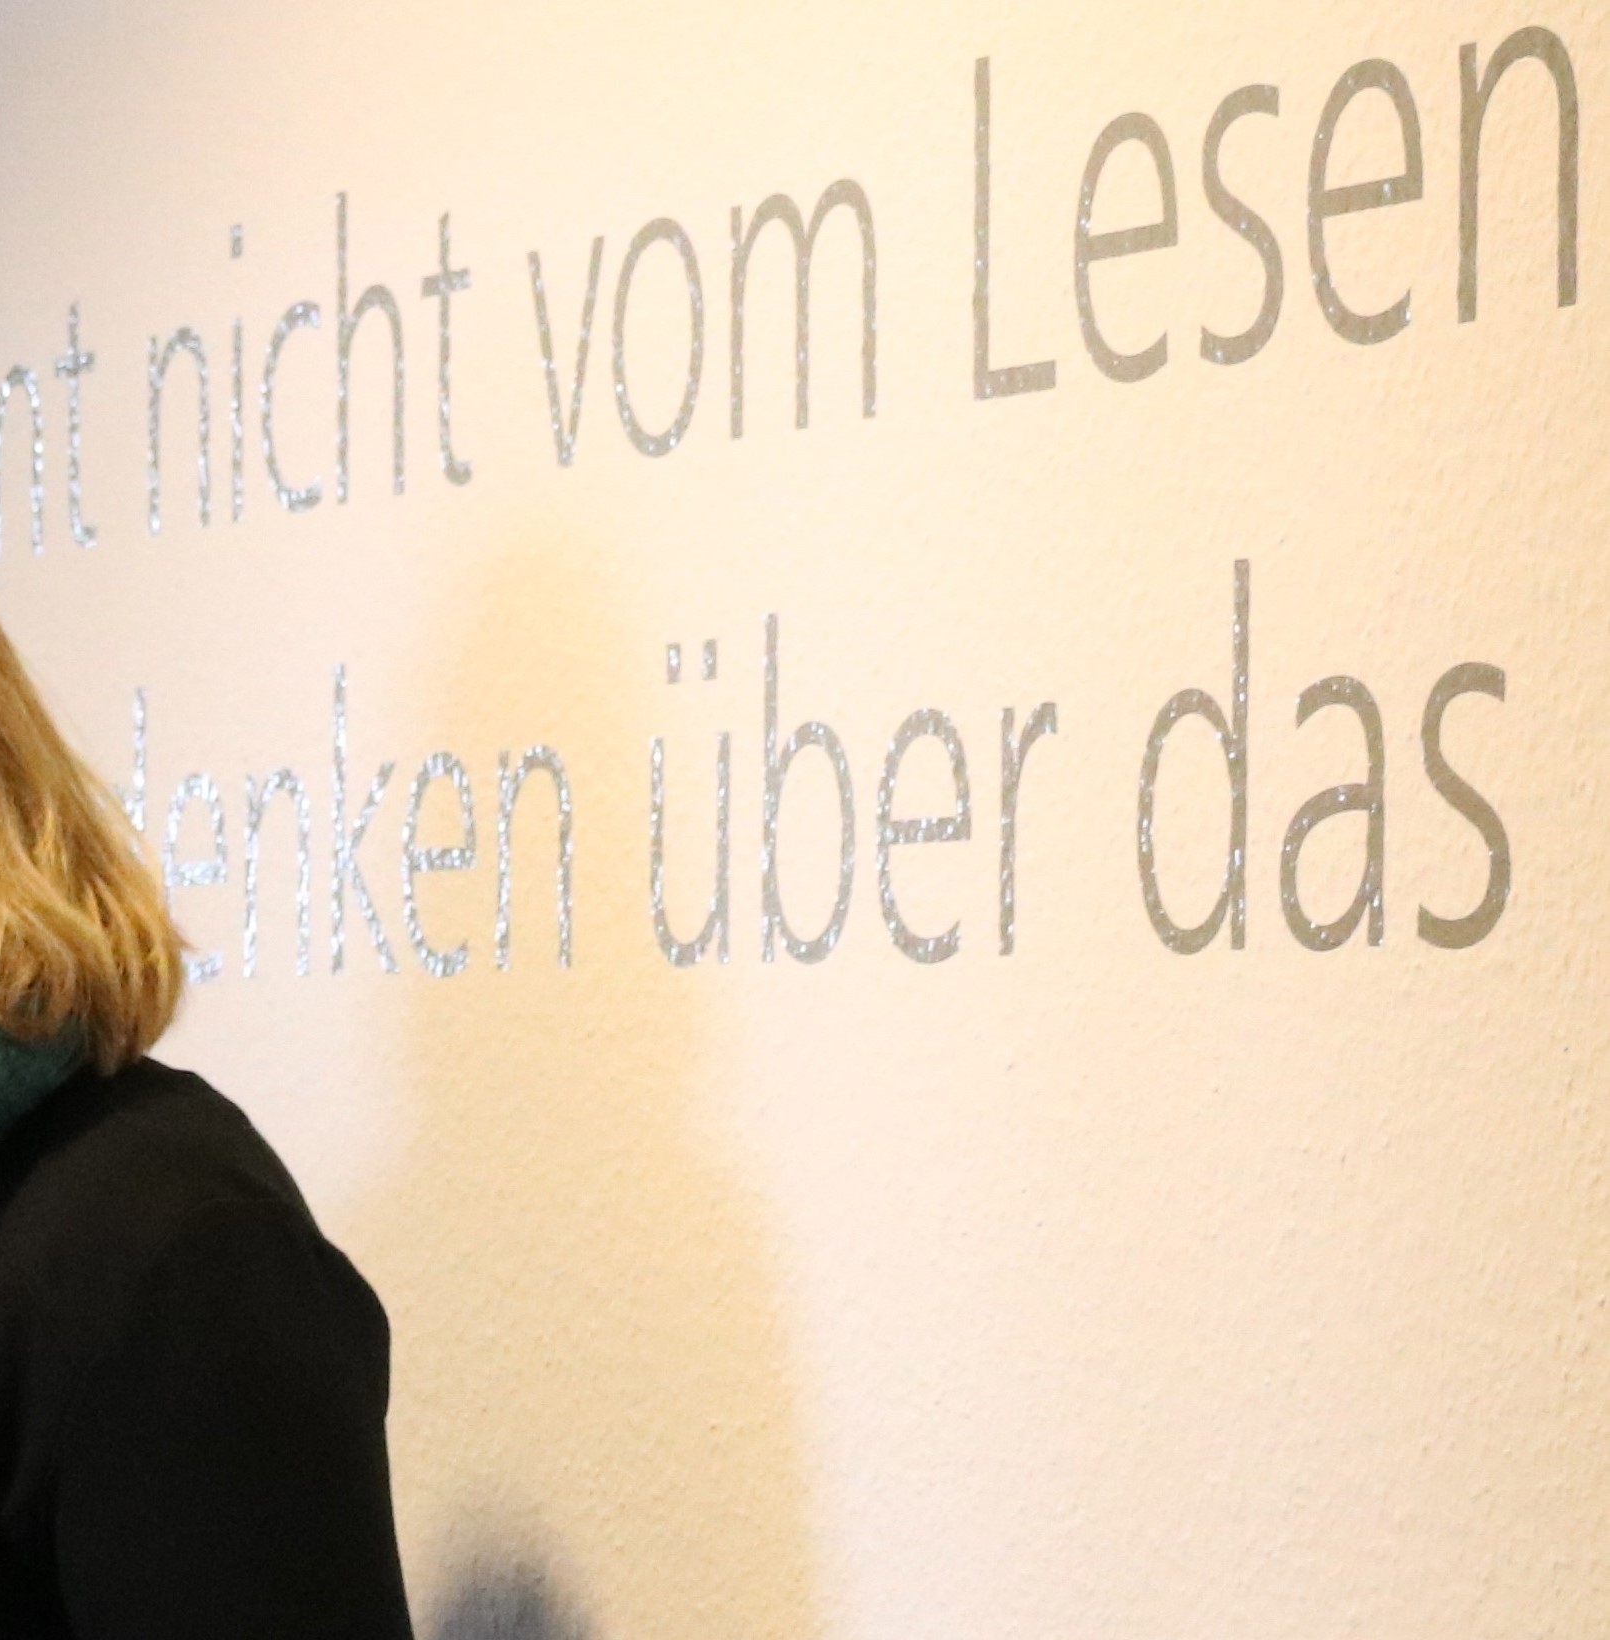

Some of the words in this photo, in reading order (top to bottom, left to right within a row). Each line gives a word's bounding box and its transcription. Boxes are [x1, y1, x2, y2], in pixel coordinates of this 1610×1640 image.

[147, 190, 473, 535] nicht
[528, 178, 878, 468] vom
[974, 25, 1579, 399] Lesen
[648, 613, 1059, 966] über
[1137, 558, 1512, 956] das
